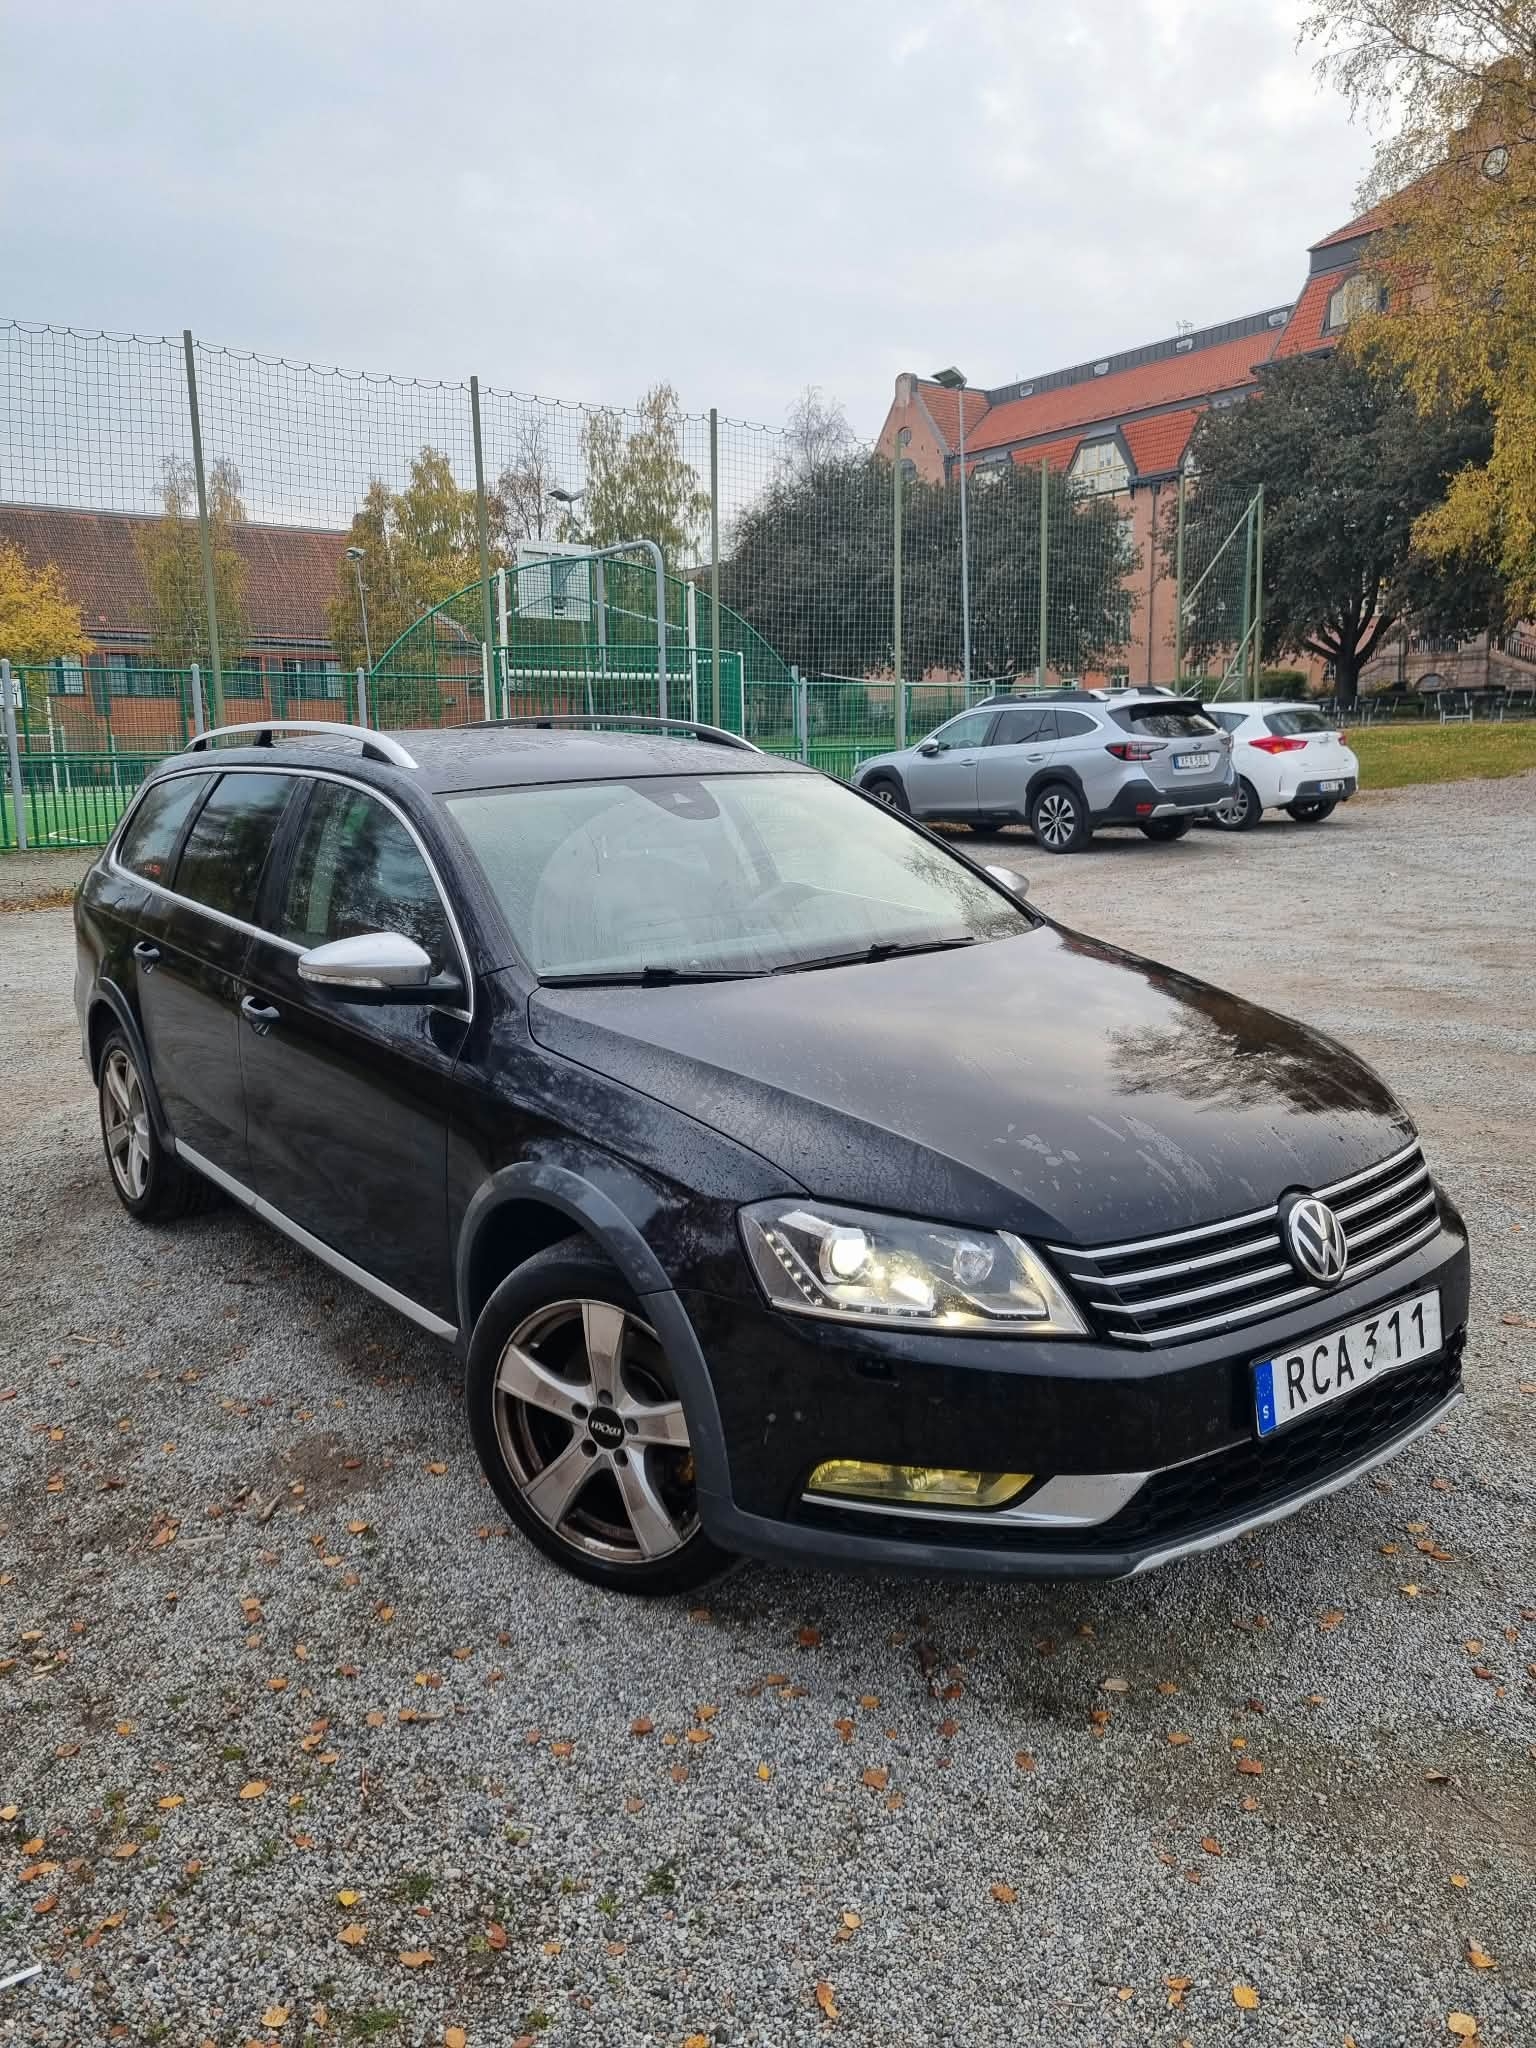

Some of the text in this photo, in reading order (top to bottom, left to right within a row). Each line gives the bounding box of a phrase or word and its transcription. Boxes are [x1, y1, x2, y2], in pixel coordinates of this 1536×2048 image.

[1288, 1198, 1348, 1282] VW
[1286, 1301, 1426, 1410] RCA 311
[1263, 1405, 1270, 1419] S
